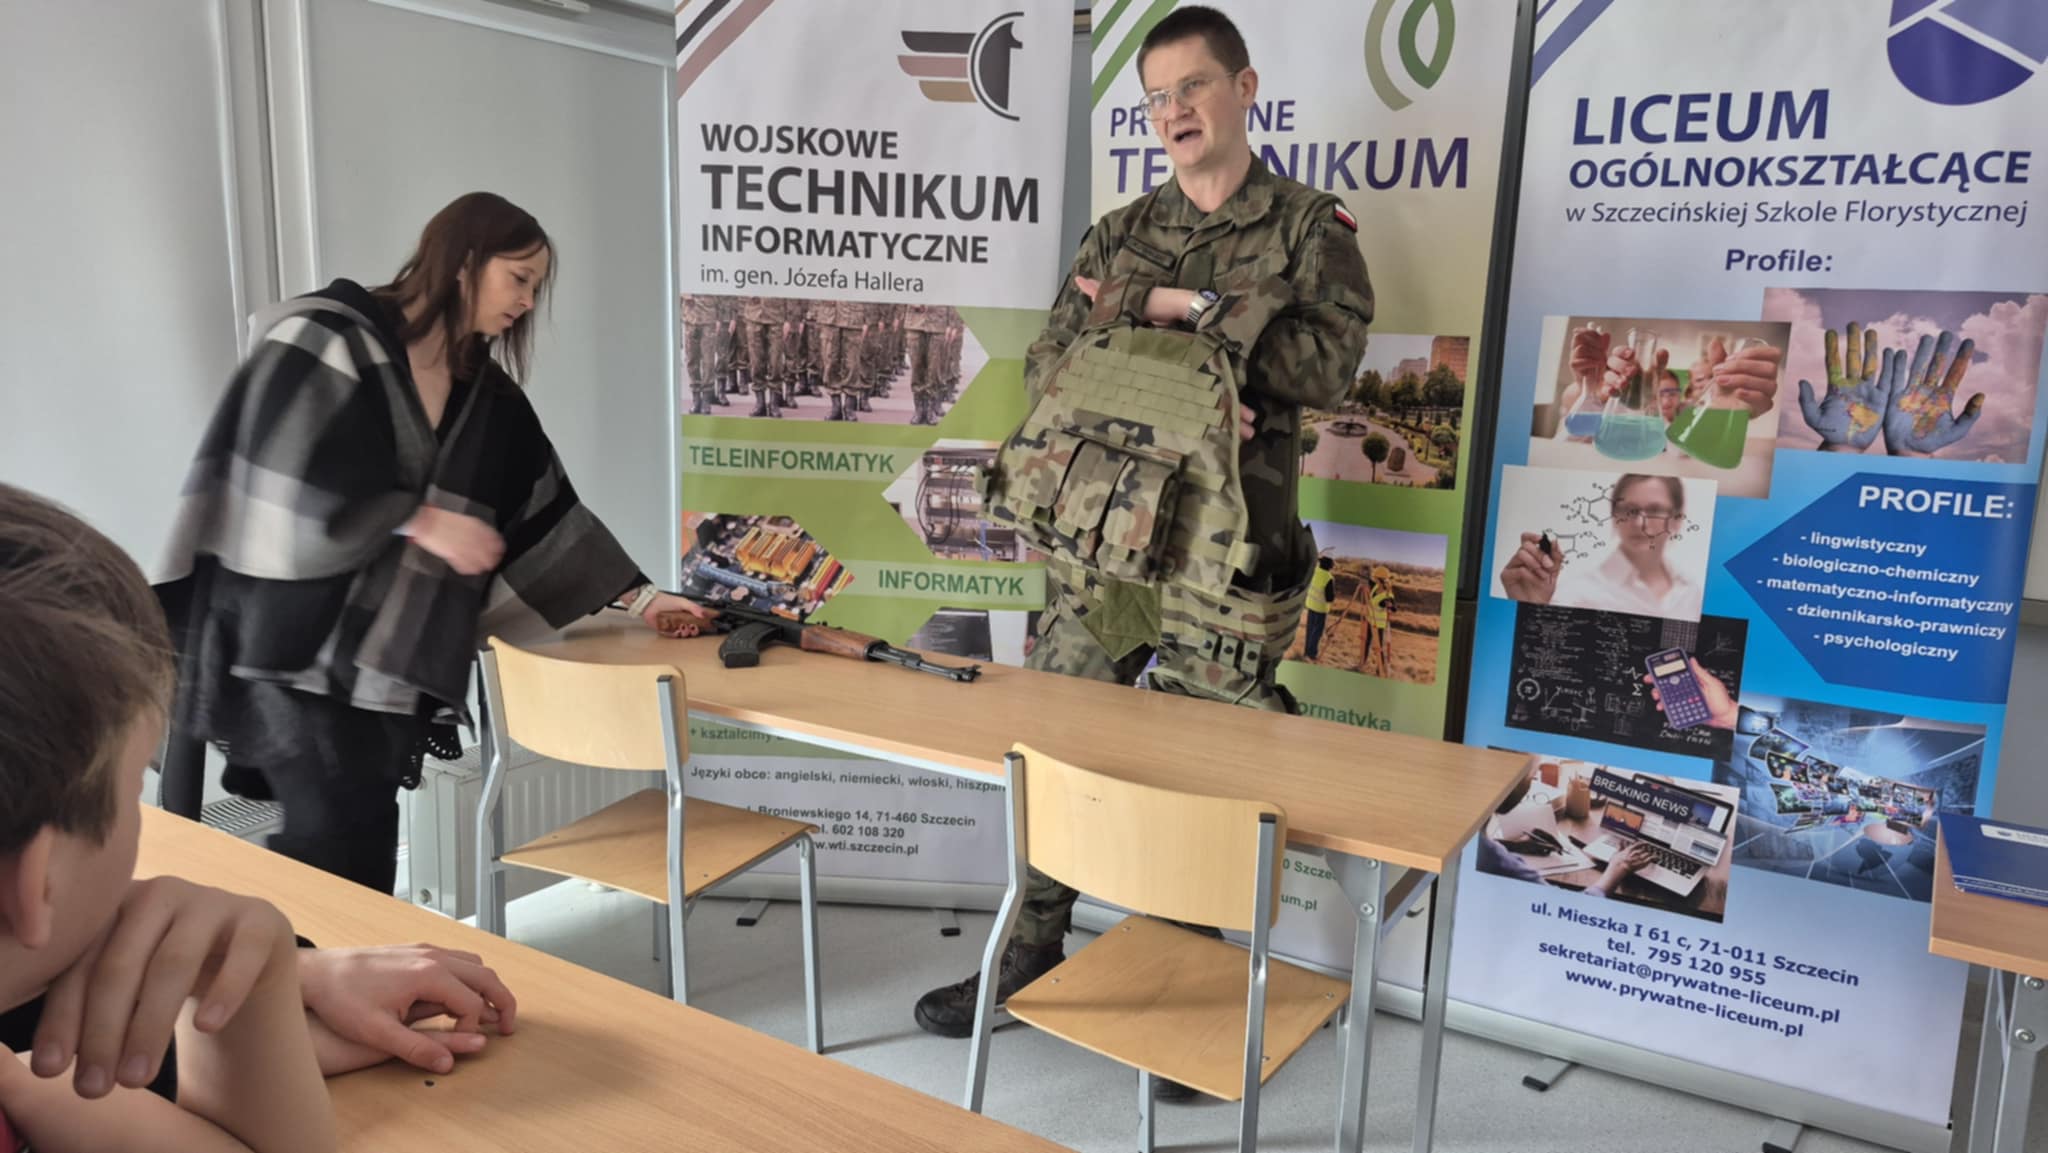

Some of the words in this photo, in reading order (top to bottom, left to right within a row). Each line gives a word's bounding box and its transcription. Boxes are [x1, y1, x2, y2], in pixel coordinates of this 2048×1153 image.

[1110, 100, 1295, 137] PRNE
[1572, 88, 1830, 145] LICEUM
[700, 123, 899, 160] WOJSKOWE
[1110, 137, 1469, 194] TENIKUM
[1569, 150, 2032, 192] OGÓLNOKSZTAŁCĄCE
[700, 164, 1040, 224] TECHNIKUM
[1565, 206, 1585, 222] w
[1592, 201, 1749, 228] Szczecińskiej
[1755, 201, 1838, 223] Szkole
[1844, 199, 2028, 228] Florystycznej
[701, 223, 989, 264] INFORMATYCZNE
[1725, 248, 1833, 272] Profile:
[700, 264, 729, 283] im.
[734, 269, 778, 289] gen.
[783, 266, 848, 289] Józefa
[855, 271, 924, 292] Hallera
[689, 446, 895, 474] TELEINFORMATYK
[1858, 485, 2014, 519] PROFILE:
[1811, 531, 1927, 557] lingwistyczny
[878, 569, 1024, 596] INFORMATYK
[1782, 553, 1980, 588] biologiczno-chemiczny
[1766, 577, 2014, 616] matematyczno-informatyczny
[1797, 603, 2006, 640] dziennikarsko-prawniczy
[1823, 631, 1959, 662] psychologiczny
[1298, 702, 1392, 732] ormatyka
[690, 766, 731, 780] Języki
[734, 768, 771, 780] obce:
[774, 769, 836, 785] angielski,
[840, 772, 904, 787] niemiecki,
[1592, 774, 1651, 804] BREAKING
[1652, 796, 1690, 817] NEWS
[758, 805, 851, 822] Broniewskiego
[856, 810, 873, 822] 14,
[876, 811, 917, 824] 71-460
[920, 812, 976, 827] Szczecin
[832, 825, 854, 836] 602
[859, 827, 880, 837] 108
[882, 828, 905, 839] 320
[1294, 861, 1336, 881] Szcze
[1531, 901, 1552, 917] ul.
[1557, 906, 1629, 935] Mieszka
[1634, 924, 1643, 937] I
[1648, 927, 1671, 944] 61
[1677, 935, 1692, 950] c,
[1698, 938, 1767, 965] 71-011
[1772, 956, 1859, 987] Szczecin
[1607, 937, 1636, 956] tel.
[1647, 947, 1682, 965] 795
[1689, 957, 1724, 976] 120
[1729, 966, 1767, 986] 955
[1538, 940, 1841, 1024] sekretariat@prywatne-liceum.pl
[1565, 968, 1804, 1038] www.prywatne-liceum.pl
